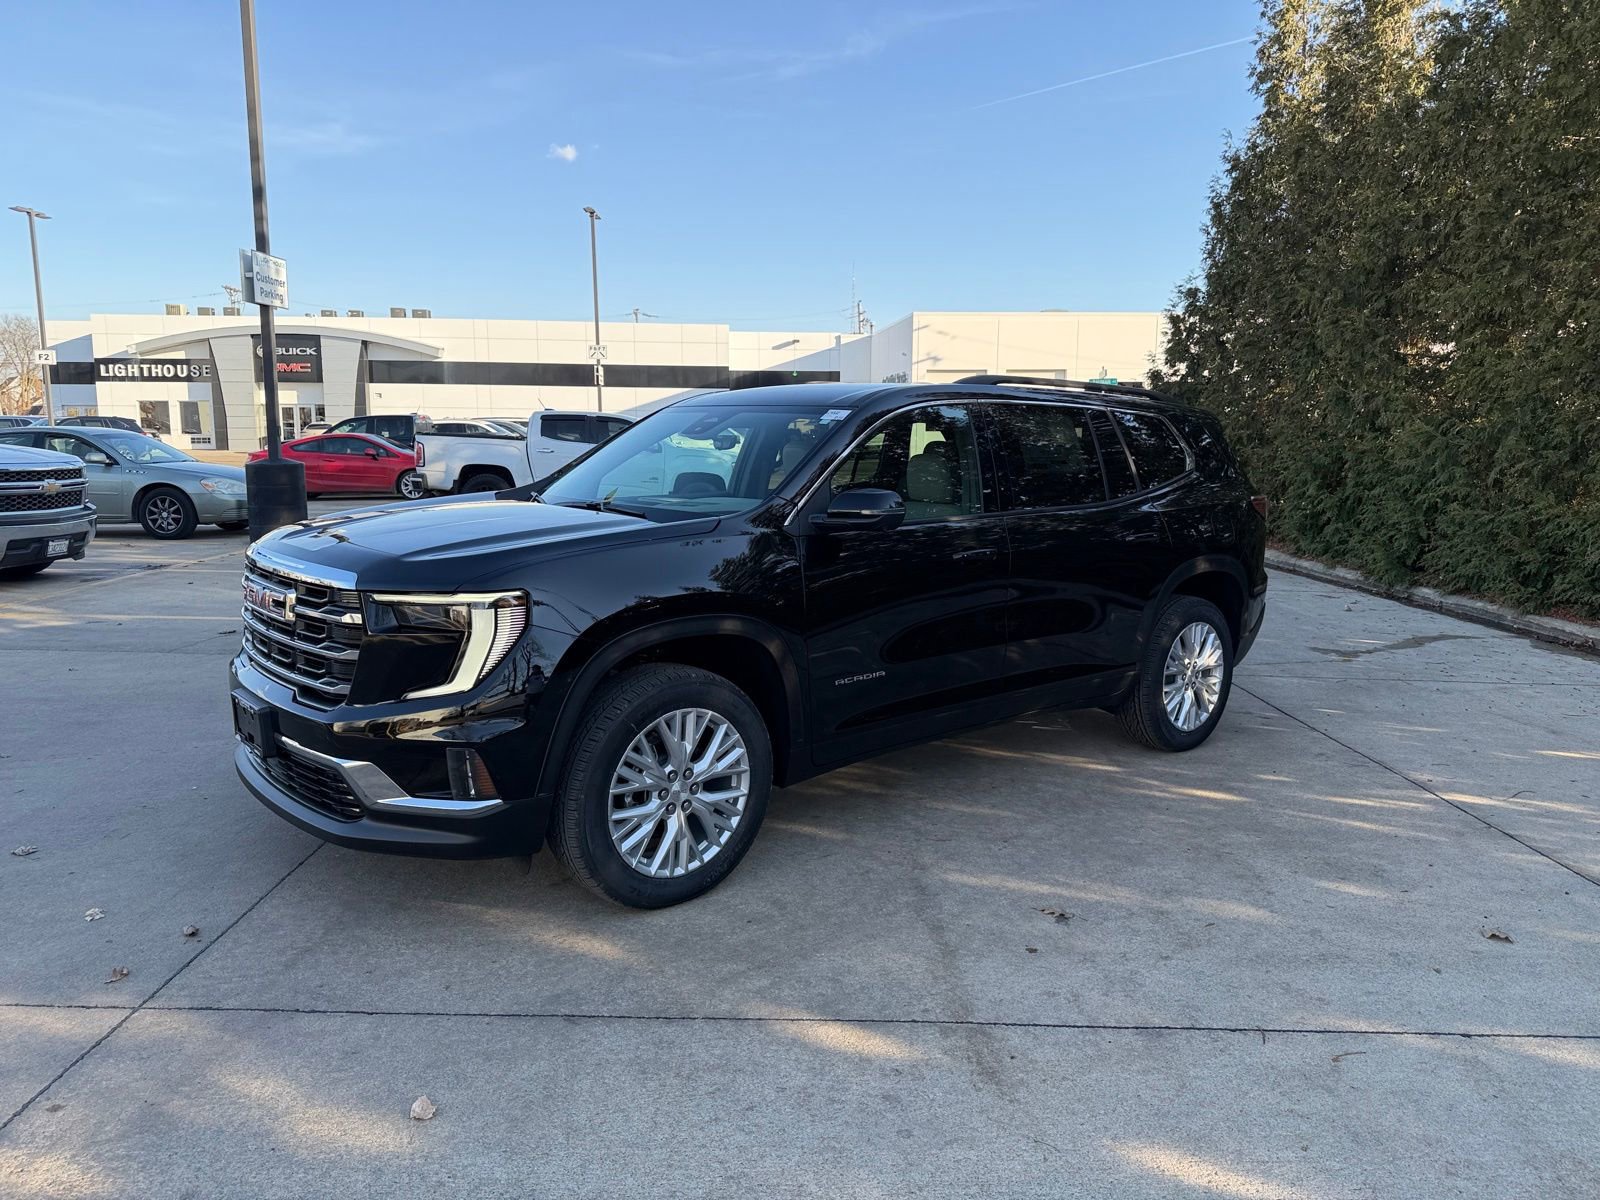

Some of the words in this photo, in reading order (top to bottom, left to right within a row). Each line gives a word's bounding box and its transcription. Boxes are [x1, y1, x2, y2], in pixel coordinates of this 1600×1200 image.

[255, 271, 286, 288] Customer
[260, 286, 284, 304] Parking
[38, 353, 50, 361] F2
[99, 364, 212, 377] LIGHTHOUSE
[243, 582, 296, 620] GMC
[834, 670, 886, 686] ACADIA
